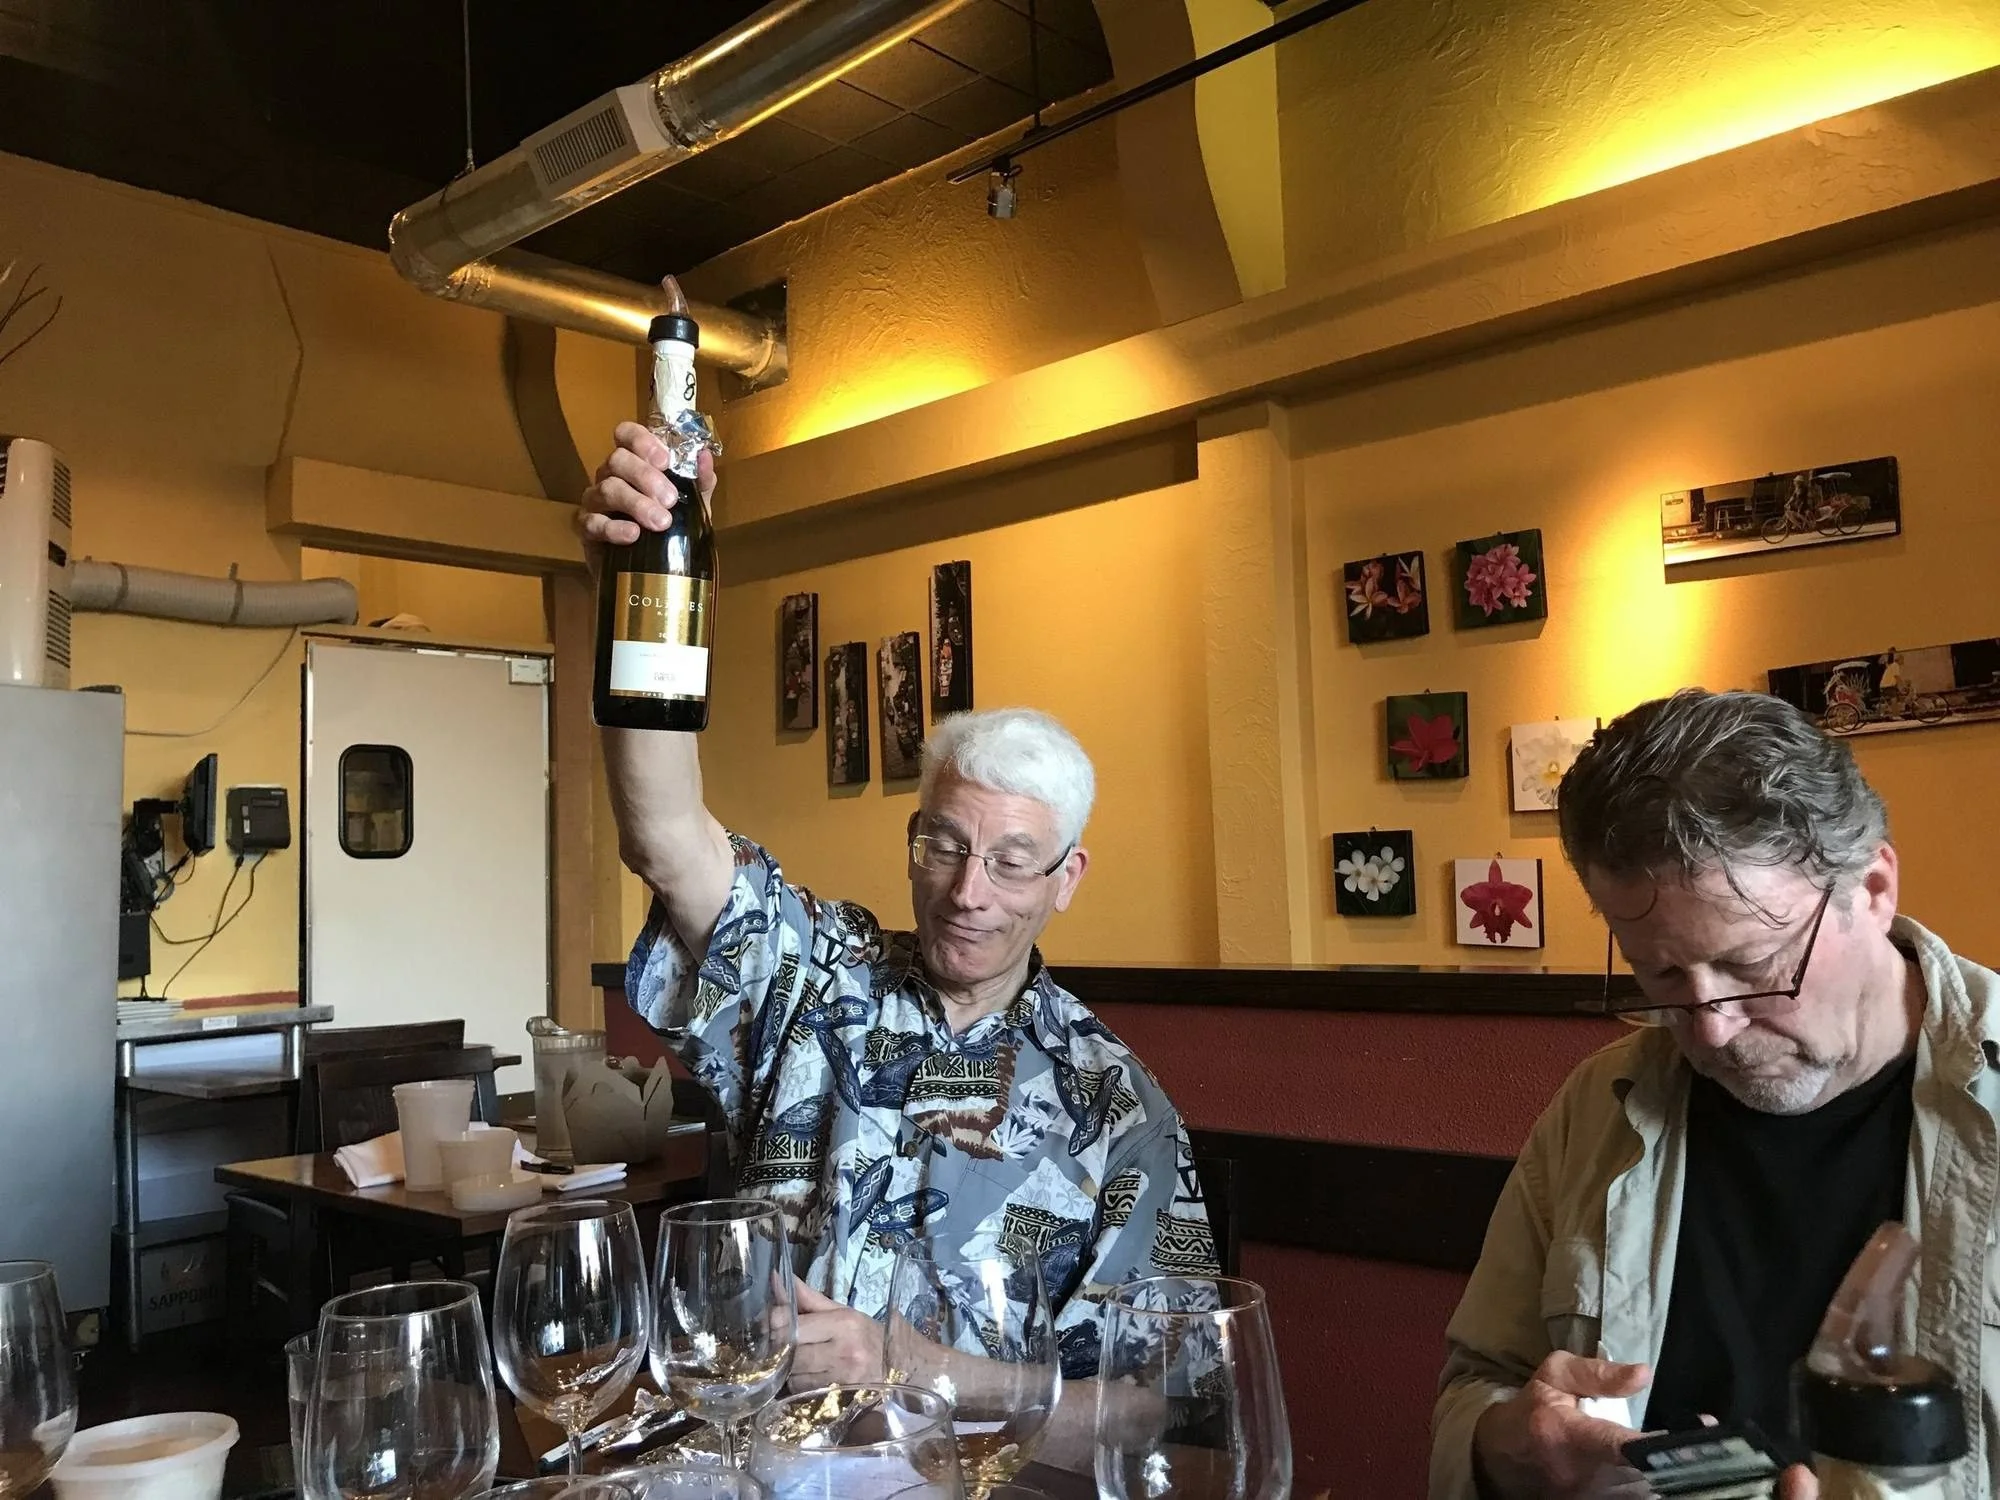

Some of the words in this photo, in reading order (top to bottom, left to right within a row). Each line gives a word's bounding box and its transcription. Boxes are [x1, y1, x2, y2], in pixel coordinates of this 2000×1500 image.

[684, 371, 696, 401] 8
[628, 594, 704, 613] COLES
[147, 1284, 219, 1312] SAPPORO
